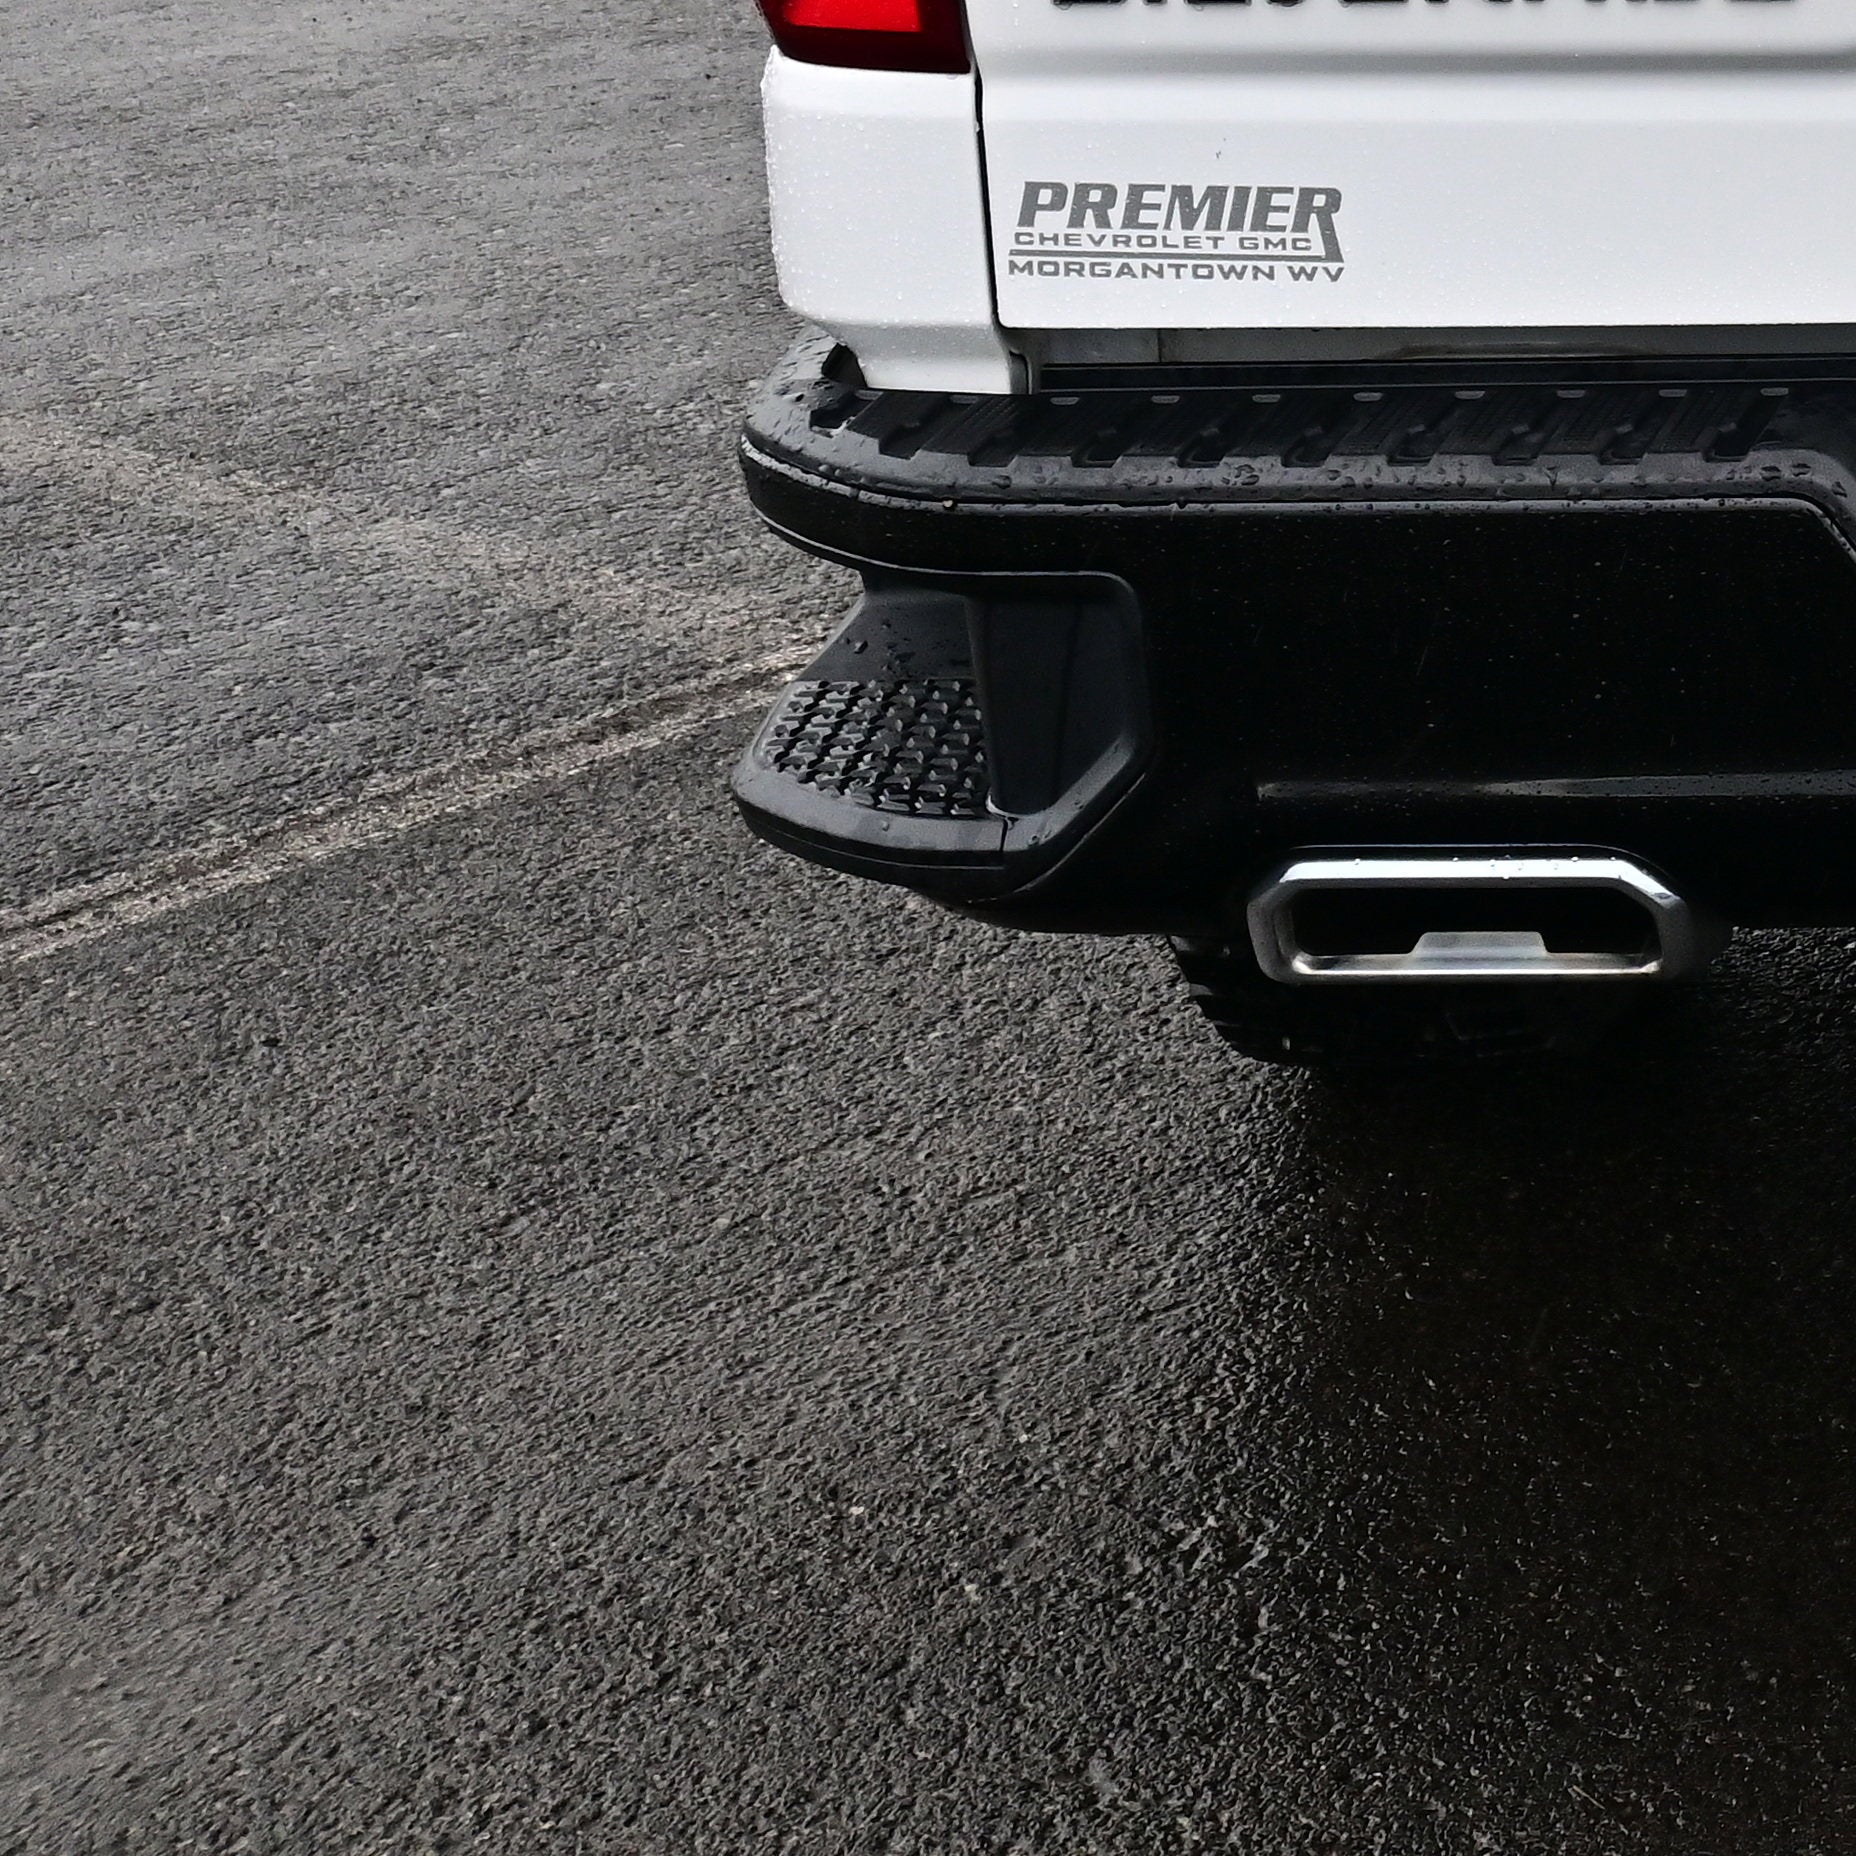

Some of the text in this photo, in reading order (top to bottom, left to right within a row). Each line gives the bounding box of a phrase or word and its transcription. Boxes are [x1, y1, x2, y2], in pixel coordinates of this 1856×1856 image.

[1016, 181, 1344, 263] PREMIER
[1013, 231, 1312, 251] CHEVROLET GMC
[1007, 259, 1345, 282] MORGANTOWN WV
